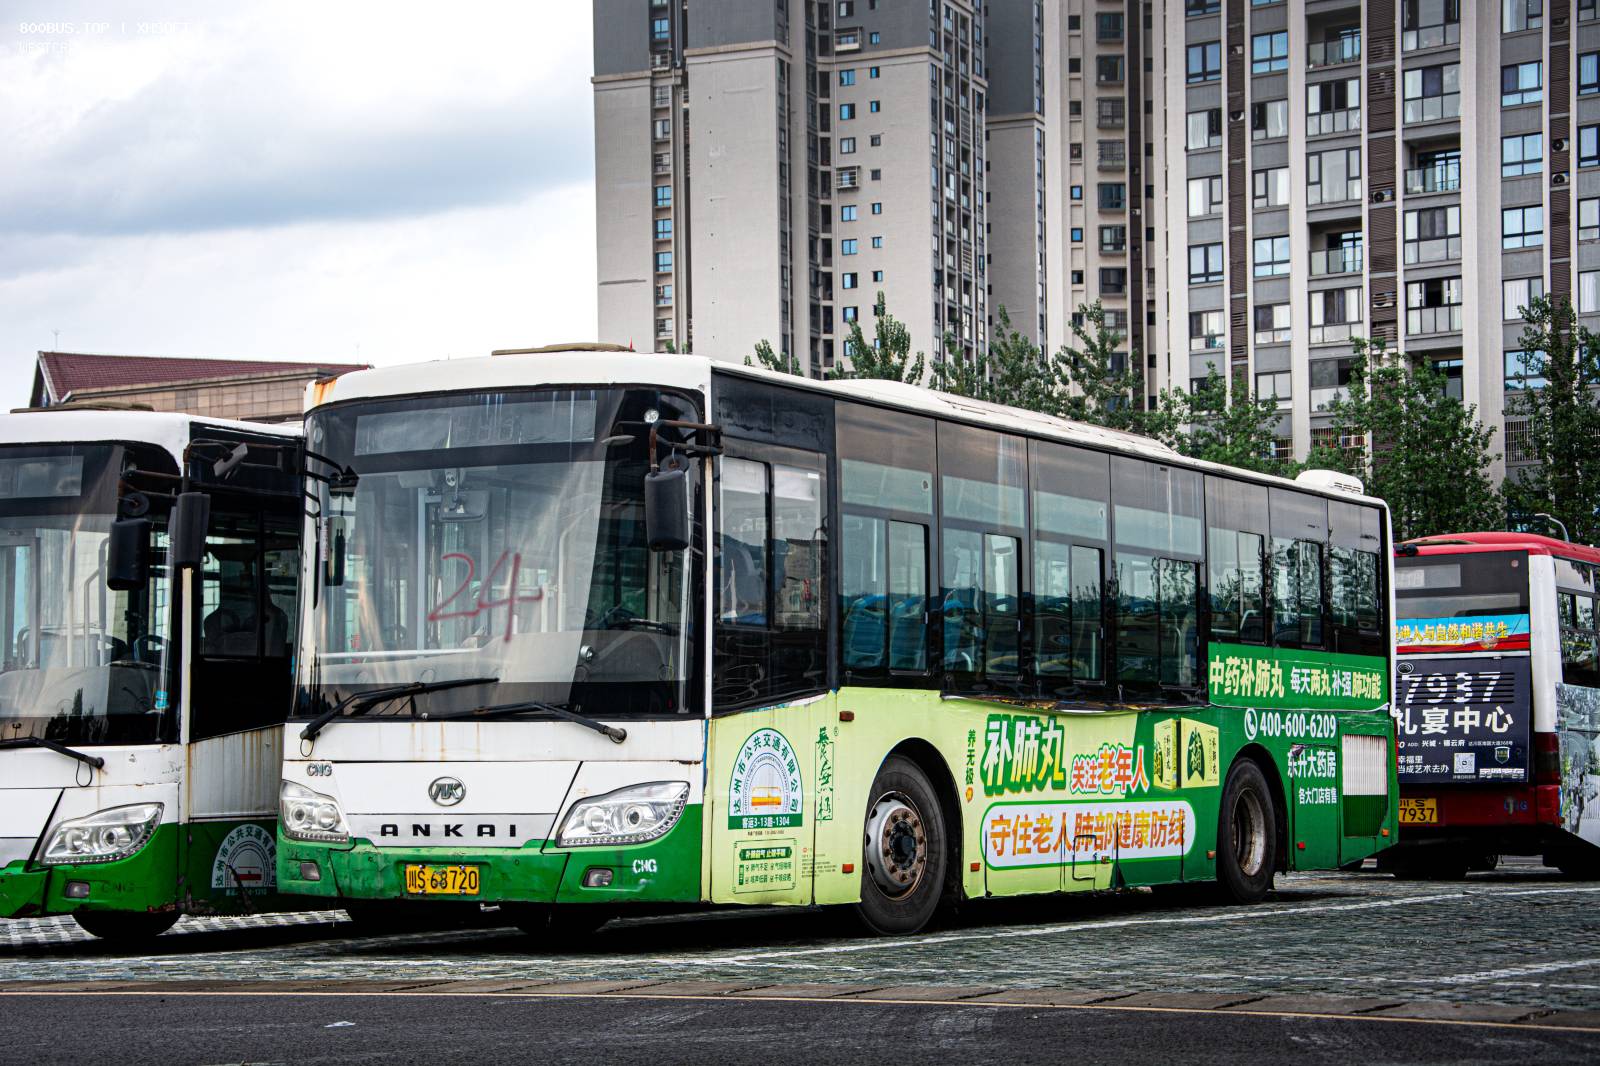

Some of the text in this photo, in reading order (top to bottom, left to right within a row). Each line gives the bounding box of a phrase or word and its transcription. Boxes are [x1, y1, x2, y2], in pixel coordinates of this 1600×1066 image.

[427, 551, 543, 642] 24
[1396, 622, 1509, 641] 进人与自然和谐共生
[1210, 655, 1382, 699] 中药补肺丸 每天两丸 补强肺功能
[1401, 672, 1501, 704] 7937
[1260, 712, 1336, 738] 400-600-6209
[1396, 706, 1514, 736] 礼宴中心
[307, 763, 333, 776] CNG
[982, 714, 1066, 793] 补肺丸
[1072, 744, 1150, 794] 关注老年人
[734, 733, 798, 814] 达州市公共交通有限公司
[380, 824, 517, 837] ANKAI
[990, 809, 1187, 857] 守住老人肺部健康防线
[632, 858, 658, 874] CNG
